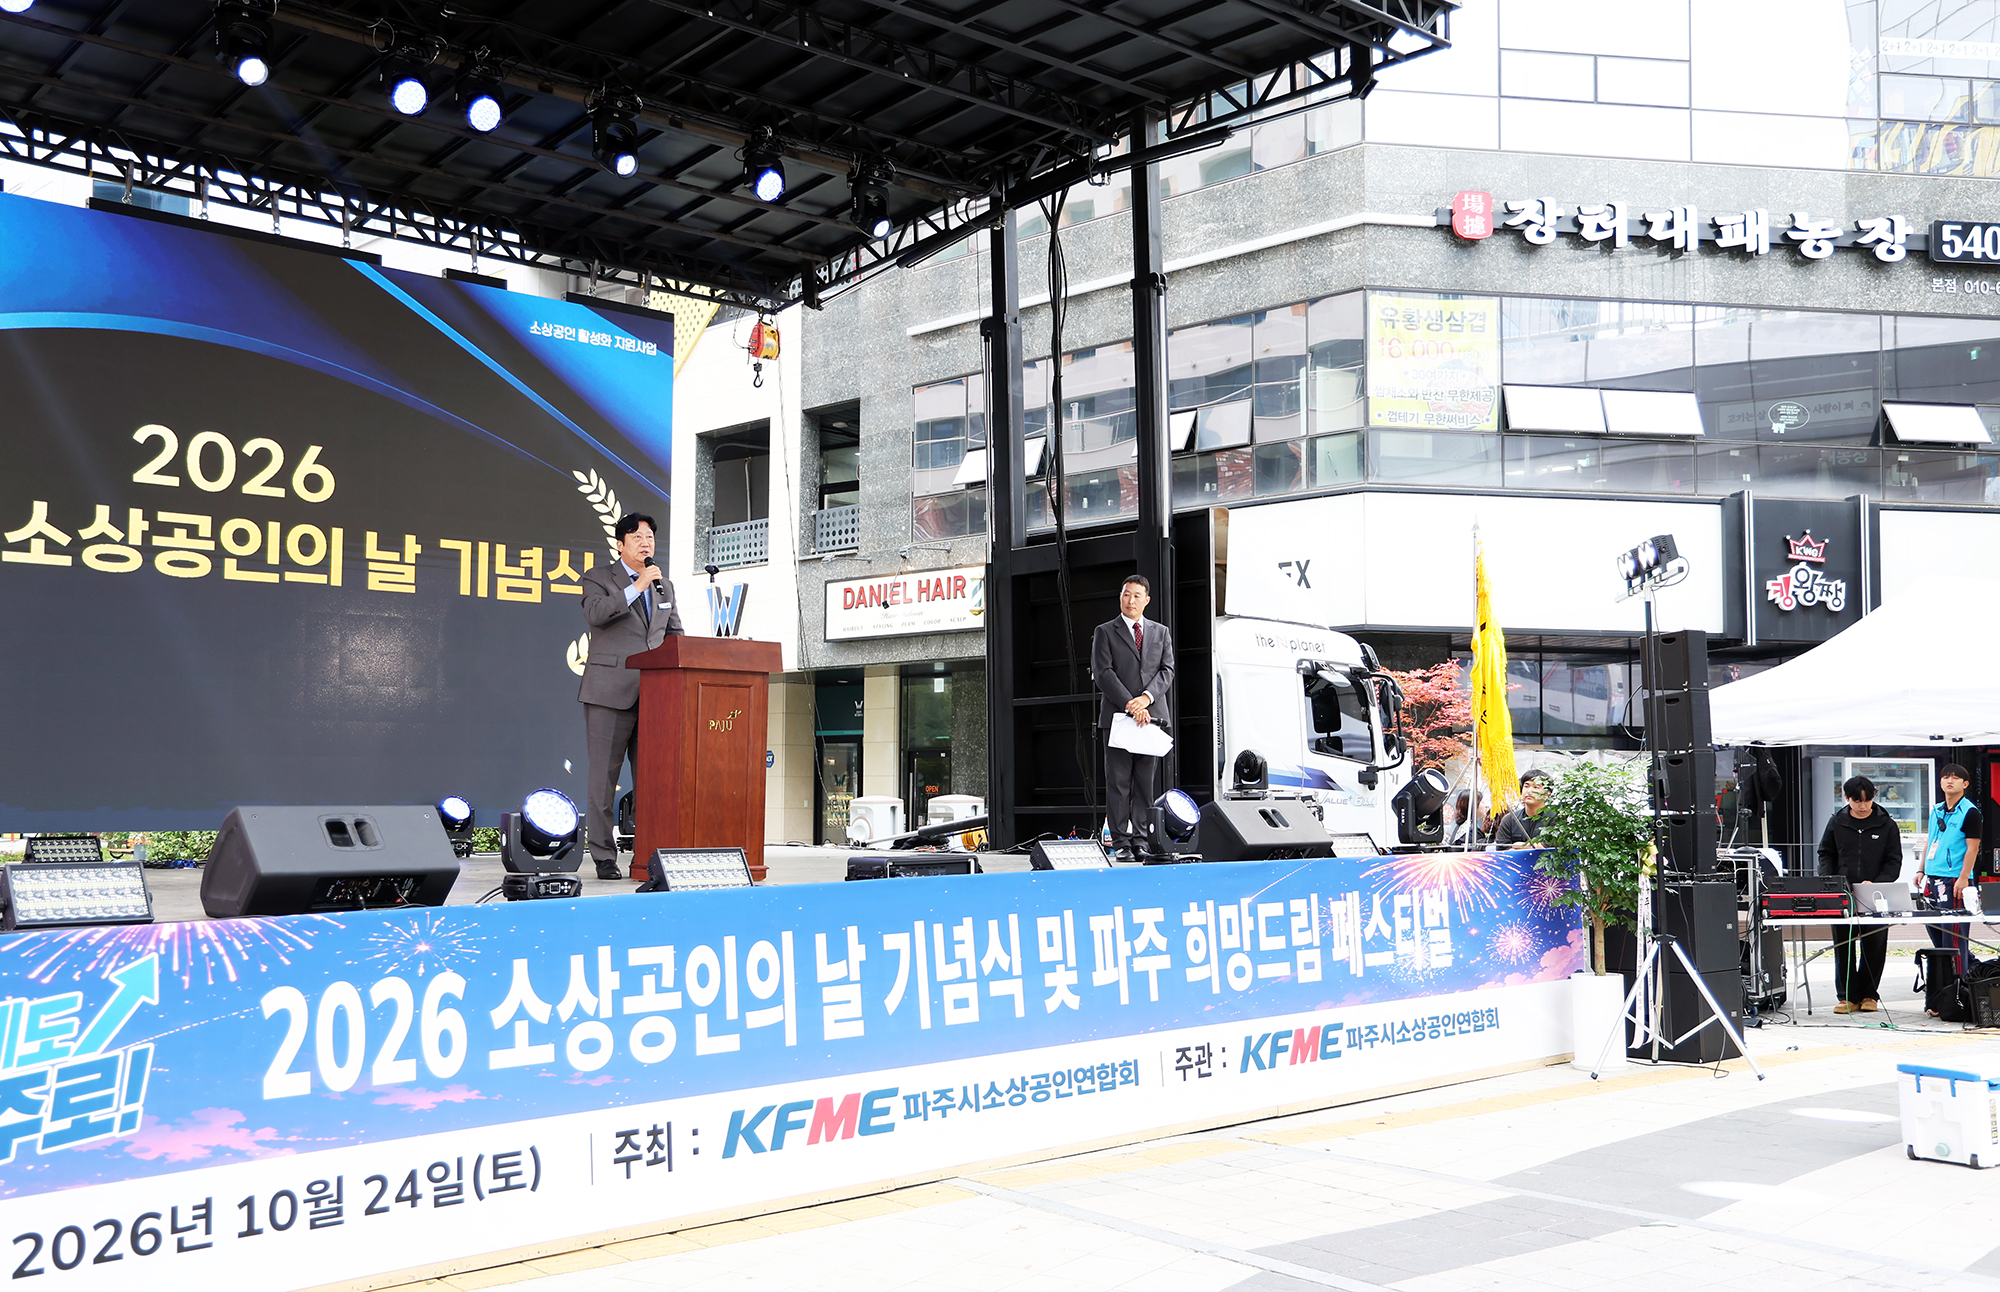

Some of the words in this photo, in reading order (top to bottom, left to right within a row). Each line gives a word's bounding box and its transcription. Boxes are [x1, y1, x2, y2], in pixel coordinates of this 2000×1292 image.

[1503, 196, 1914, 262] 장터대패농장
[1931, 277, 1957, 293] 본점
[529, 320, 576, 341] 소상공인
[613, 334, 657, 356] 지원사업
[1380, 306, 1487, 333] 유황생삼겹
[1446, 389, 1494, 403] 무한제공
[133, 423, 336, 503] 2026
[1, 500, 344, 588] 소상공인의
[365, 529, 422, 594] 날
[843, 581, 913, 610] DANIEL
[918, 575, 967, 602] HAIR
[708, 719, 733, 733] PAJU
[925, 785, 939, 793] OPEN
[260, 970, 468, 1100] 2026
[489, 930, 797, 1072] 소상공인의
[814, 925, 867, 1041] 날
[882, 910, 1026, 1030] 기념식
[1036, 908, 1080, 1014] 및
[1089, 904, 1172, 1006] 파주
[1181, 892, 1323, 995] 희망드림
[1331, 886, 1453, 978] 페스티벌
[1175, 1042, 1213, 1082] 주관
[1240, 1022, 1344, 1074] KFME
[1346, 1006, 1500, 1051] 파주시소상공인연합회
[613, 1120, 673, 1180] 주최
[721, 1087, 899, 1160] KFME
[903, 1059, 1140, 1122] 파주시소상공인연합회
[11, 1196, 214, 1280] 2026년
[236, 1175, 346, 1239] 10월
[363, 1144, 543, 1217] 24일(토)
